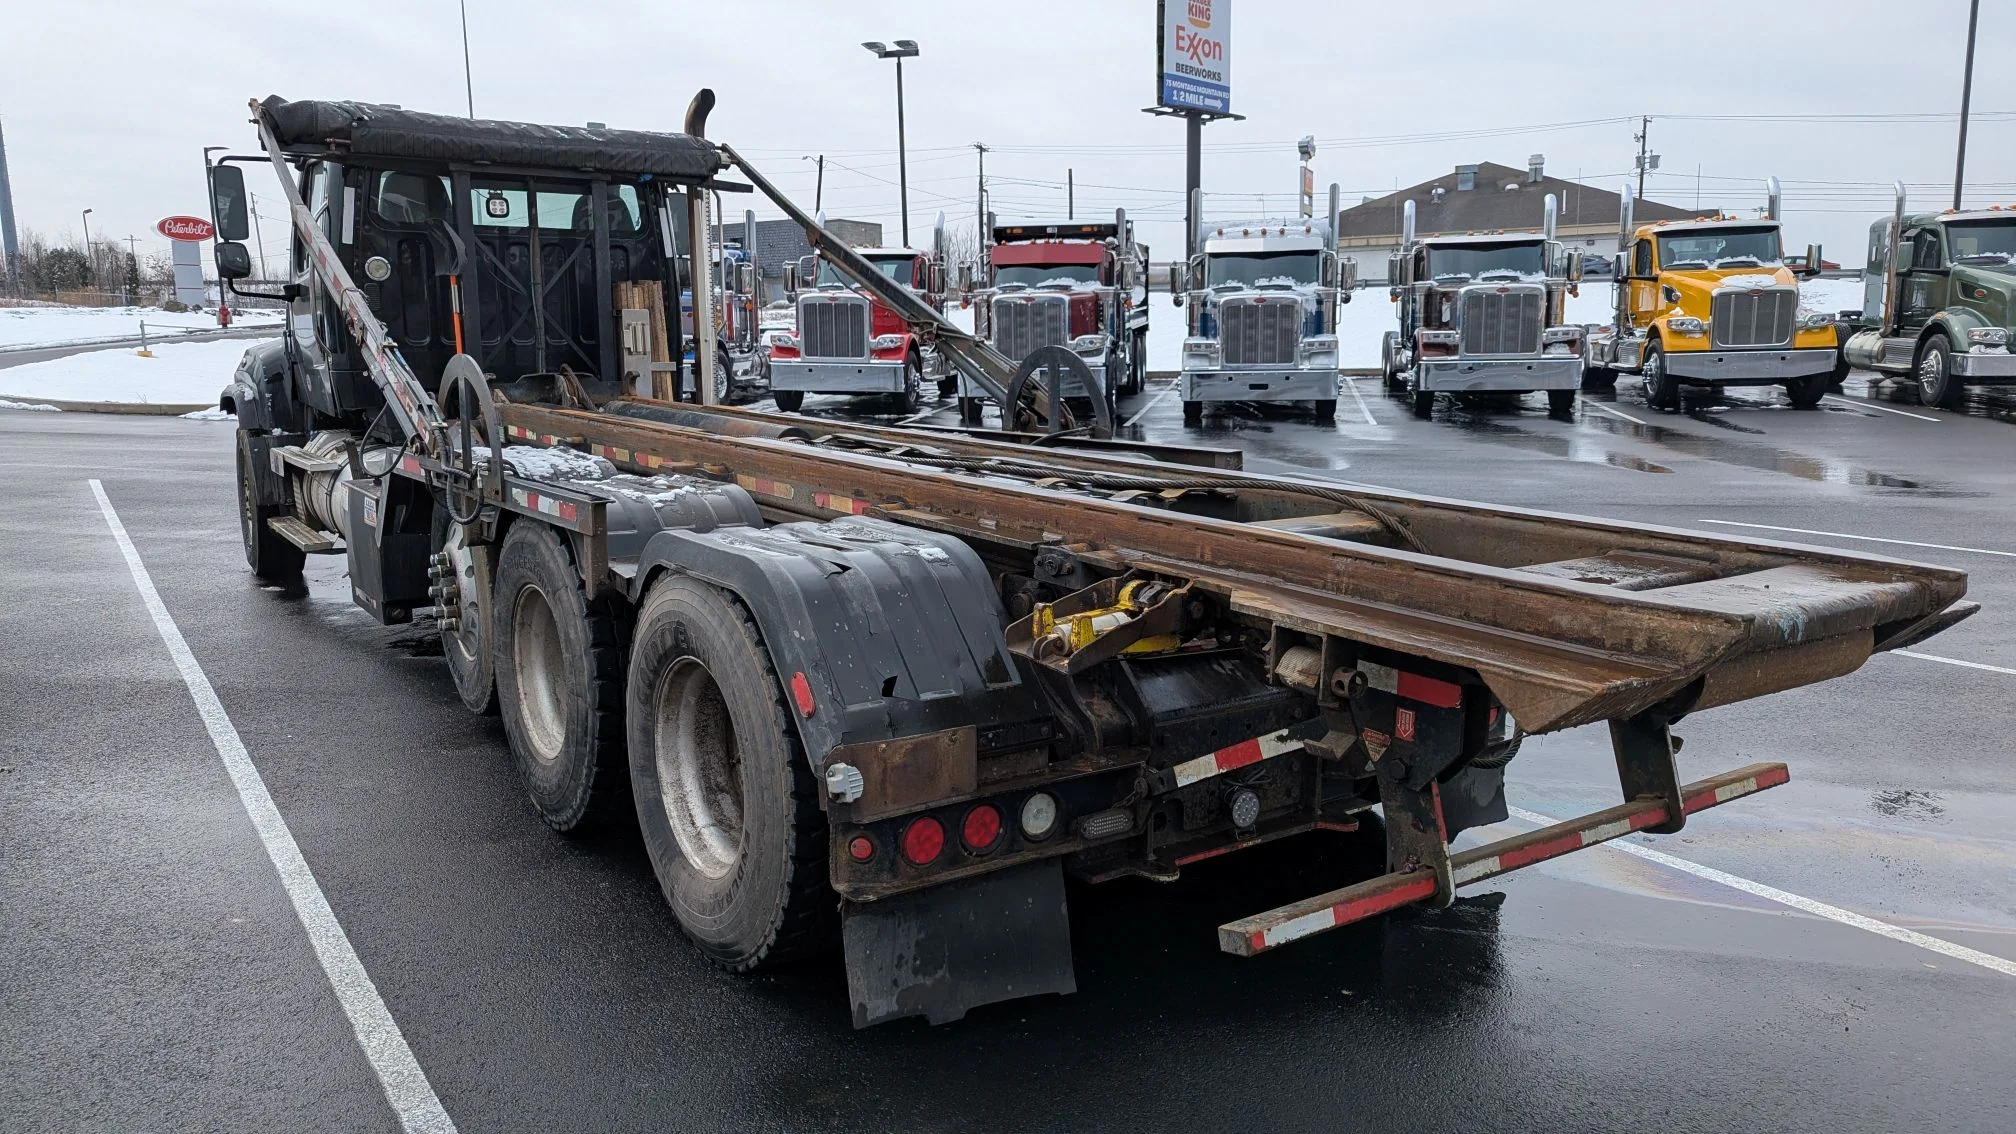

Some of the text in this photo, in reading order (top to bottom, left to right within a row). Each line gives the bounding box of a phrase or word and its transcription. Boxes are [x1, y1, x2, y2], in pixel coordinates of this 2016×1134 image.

[1188, 2, 1211, 21] KING
[1175, 62, 1222, 82] BEERWORKS
[1172, 80, 1197, 93] MONTAGE
[1197, 85, 1223, 98] MOUNTAIN
[1185, 92, 1204, 106] MILE
[165, 220, 211, 235] Peterbilt
